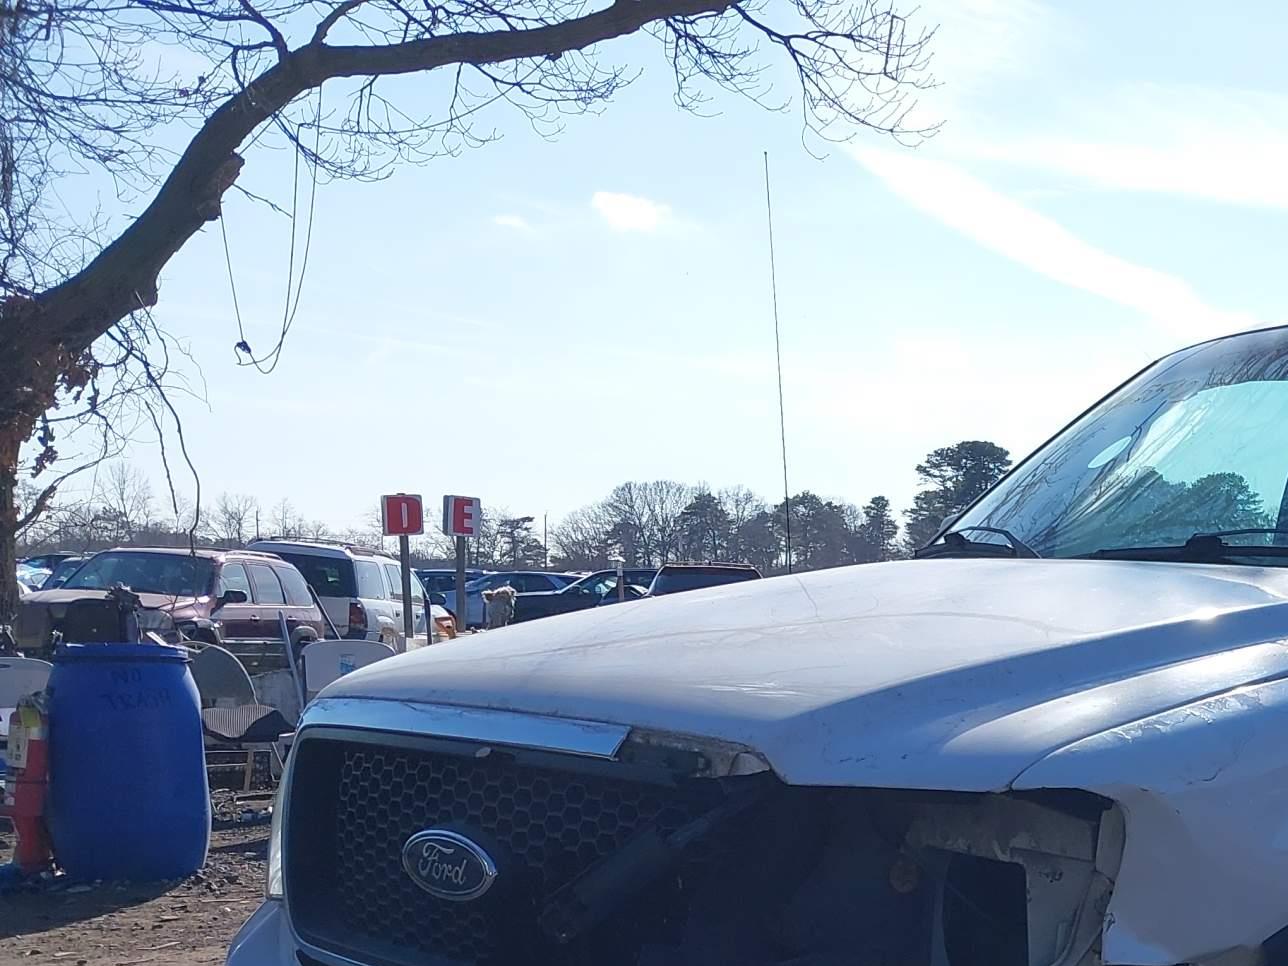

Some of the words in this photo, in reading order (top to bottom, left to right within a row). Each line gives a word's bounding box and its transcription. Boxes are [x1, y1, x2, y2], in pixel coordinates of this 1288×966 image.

[386, 496, 421, 535] D
[453, 498, 474, 534] E
[418, 841, 468, 886] Ford
